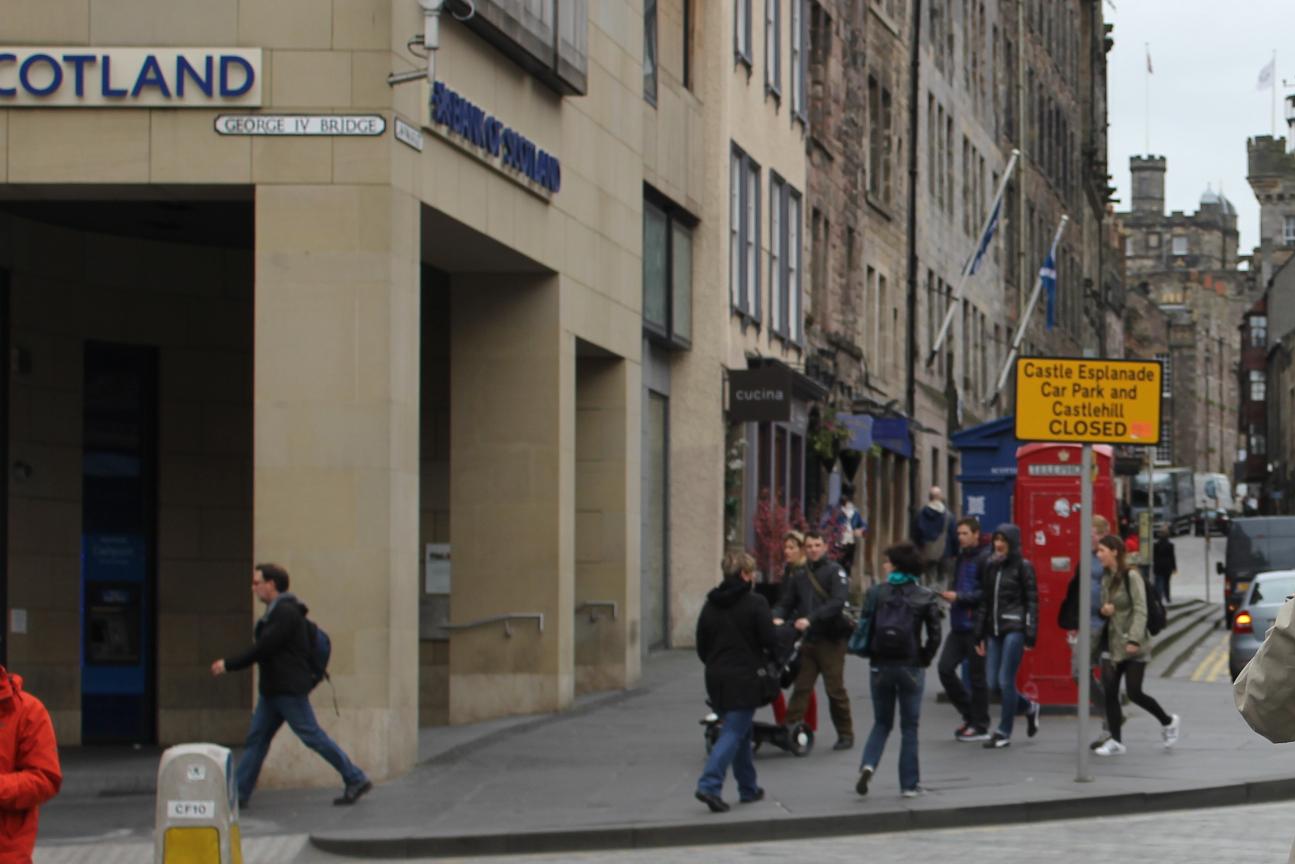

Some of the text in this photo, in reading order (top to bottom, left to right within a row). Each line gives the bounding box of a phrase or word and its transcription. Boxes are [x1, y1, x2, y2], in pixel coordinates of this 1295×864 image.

[224, 118, 377, 133] GEORGE IV BRIDGE
[502, 127, 561, 193] SCOTLAND
[1024, 362, 1154, 382] Castle Esplanade
[735, 387, 784, 400] cucina
[1041, 381, 1137, 400] Car Park and
[1052, 401, 1124, 418] Castlehill
[1049, 420, 1127, 437] CLOSED
